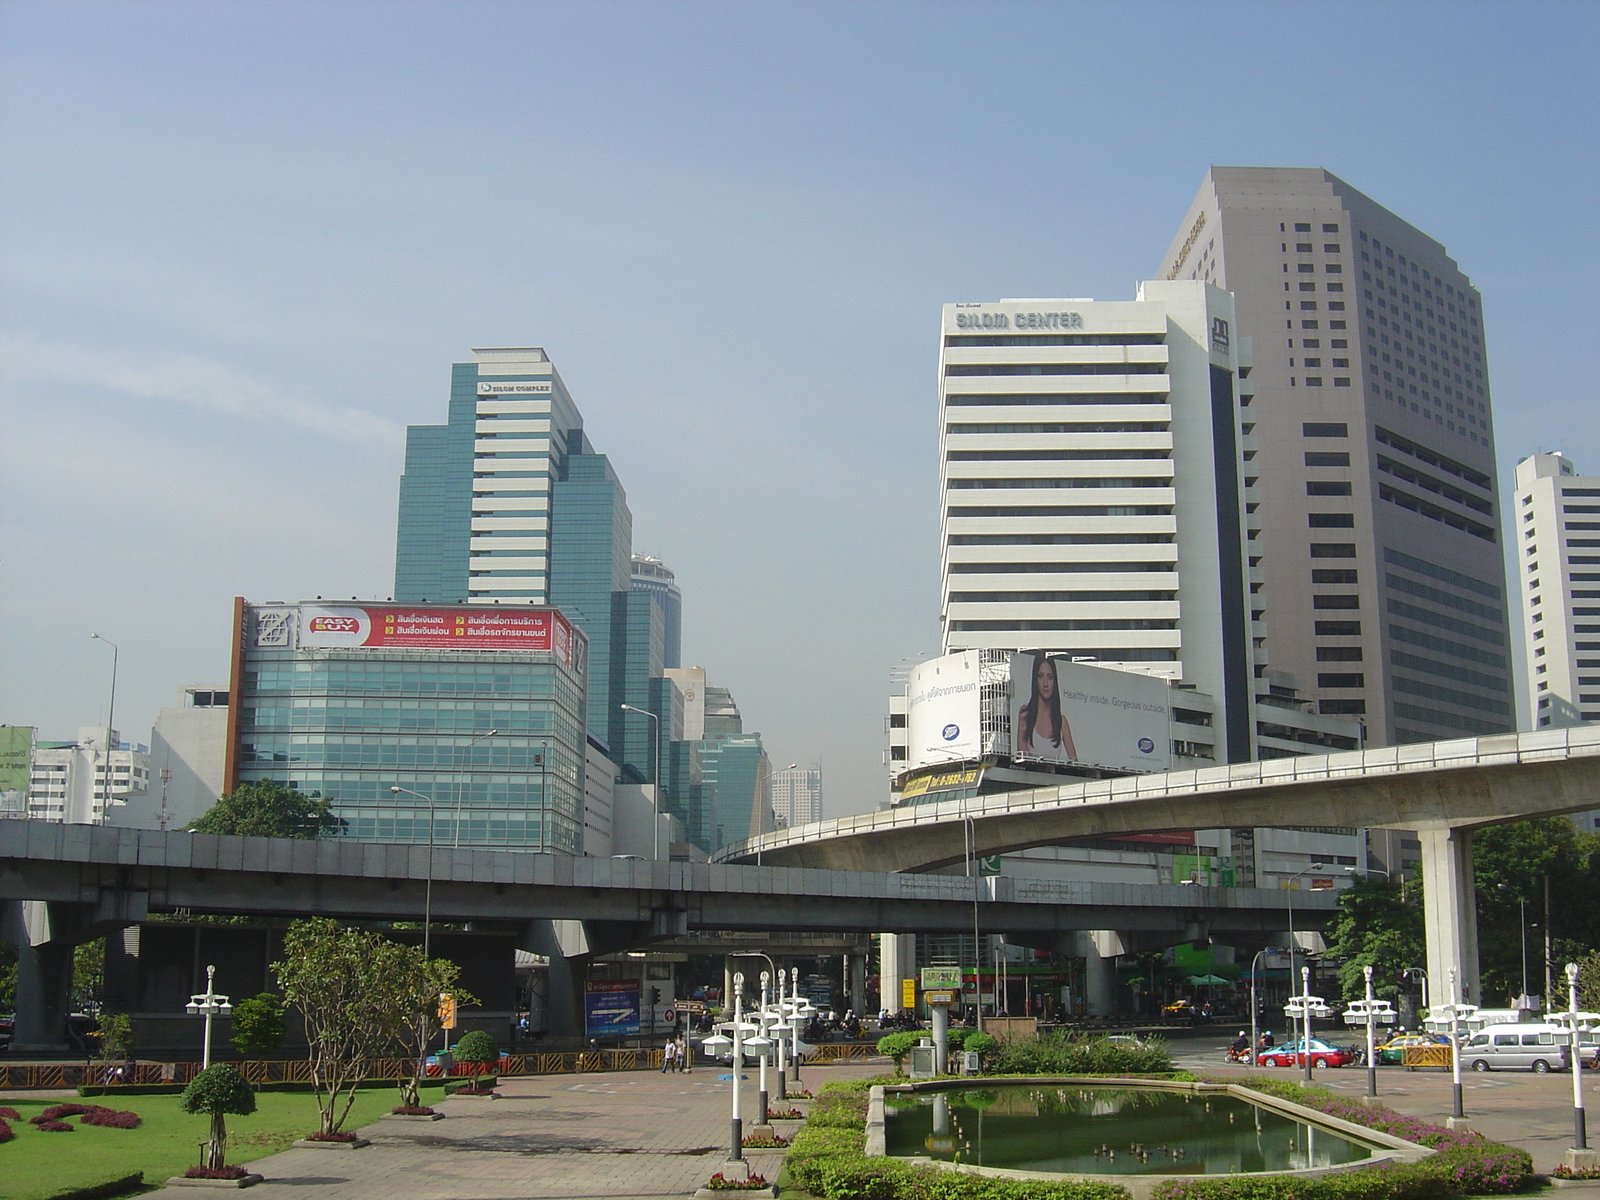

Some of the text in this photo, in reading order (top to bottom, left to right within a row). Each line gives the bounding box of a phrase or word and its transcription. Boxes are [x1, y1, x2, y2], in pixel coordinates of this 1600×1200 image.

[956, 312, 1084, 329] SILOM CENTER
[1063, 689, 1088, 704] Healthy
[1112, 696, 1142, 711] Gorgeous
